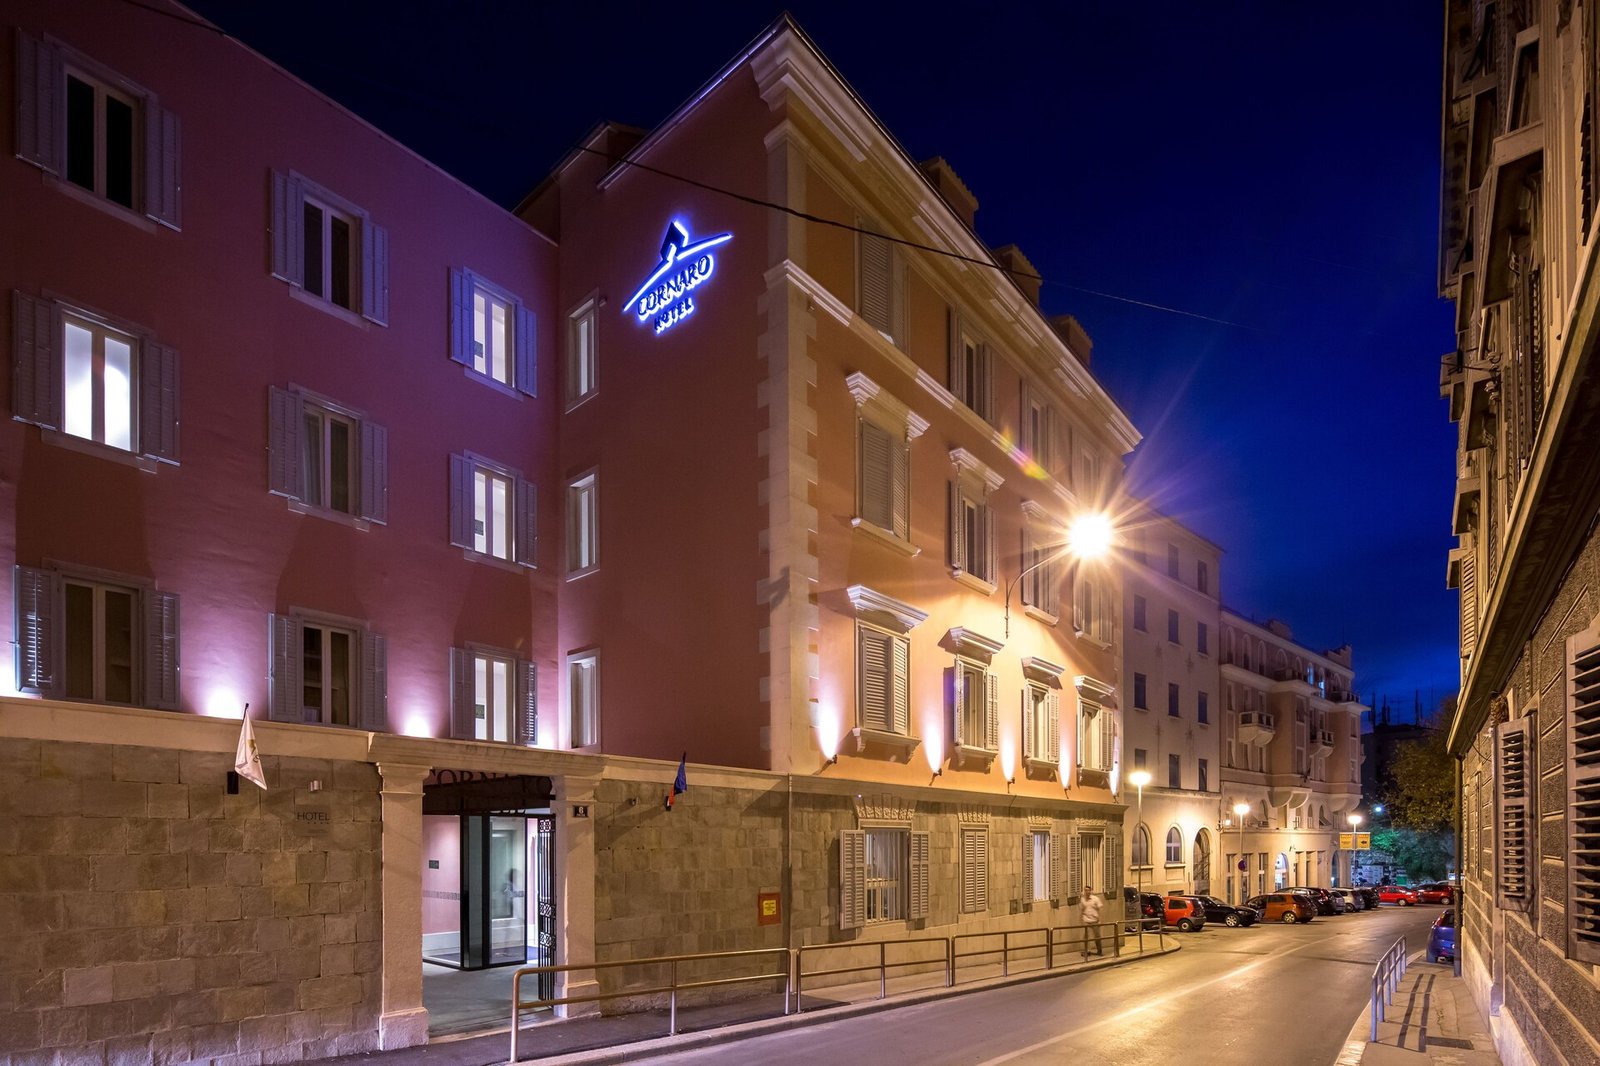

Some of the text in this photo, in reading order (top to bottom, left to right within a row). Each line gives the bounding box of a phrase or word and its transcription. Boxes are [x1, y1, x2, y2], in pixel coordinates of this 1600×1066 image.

[637, 254, 714, 320] CORNARO
[653, 297, 694, 334] HOTEL
[297, 812, 330, 821] HOTEL
